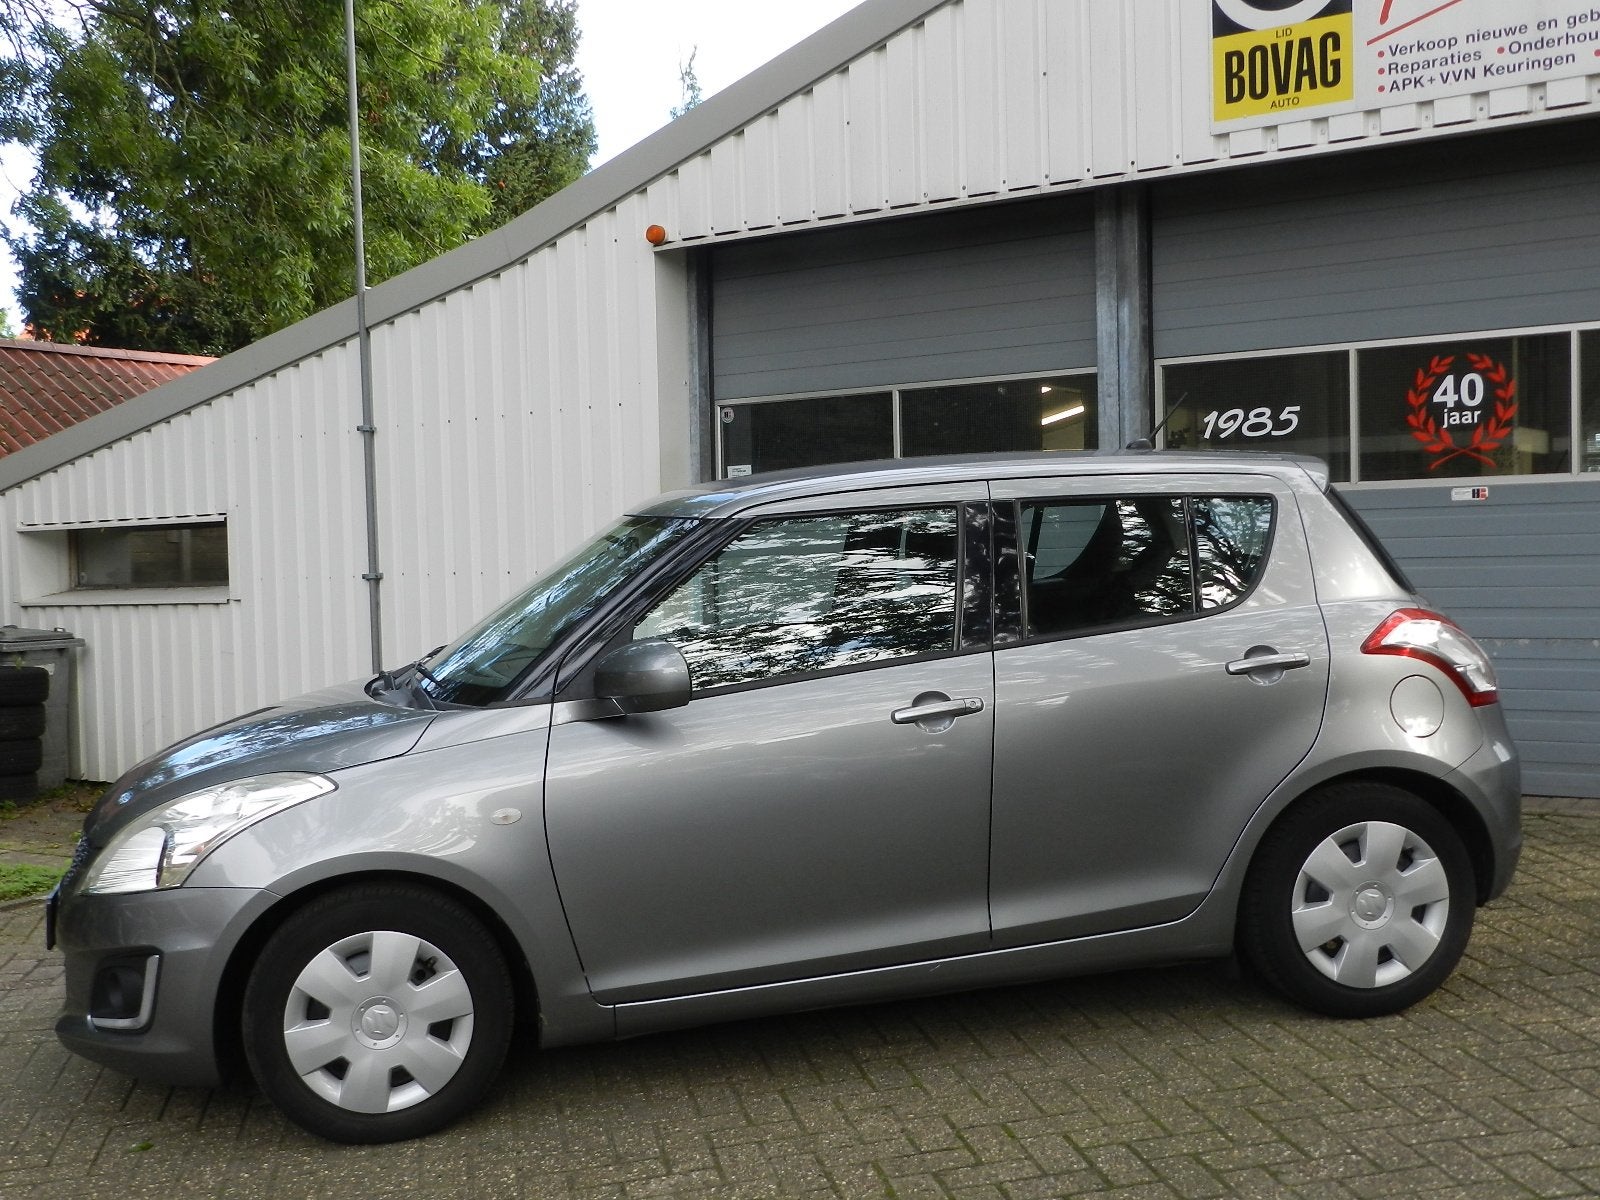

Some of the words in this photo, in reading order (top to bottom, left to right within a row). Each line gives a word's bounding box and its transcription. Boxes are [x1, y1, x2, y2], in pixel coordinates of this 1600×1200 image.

[1275, 27, 1293, 39] LID
[1388, 36, 1458, 57] Verkoop
[1465, 23, 1528, 44] nieuwe
[1536, 18, 1558, 31] en
[1508, 30, 1599, 55] Onderhou
[1224, 31, 1341, 105] BOVAG
[1388, 50, 1482, 75] Reparaties
[1483, 53, 1576, 77] Keuringen
[1270, 96, 1300, 110] AUTO
[1432, 372, 1484, 408] 40
[1203, 405, 1301, 440] 1985
[1442, 408, 1481, 429] jaar
